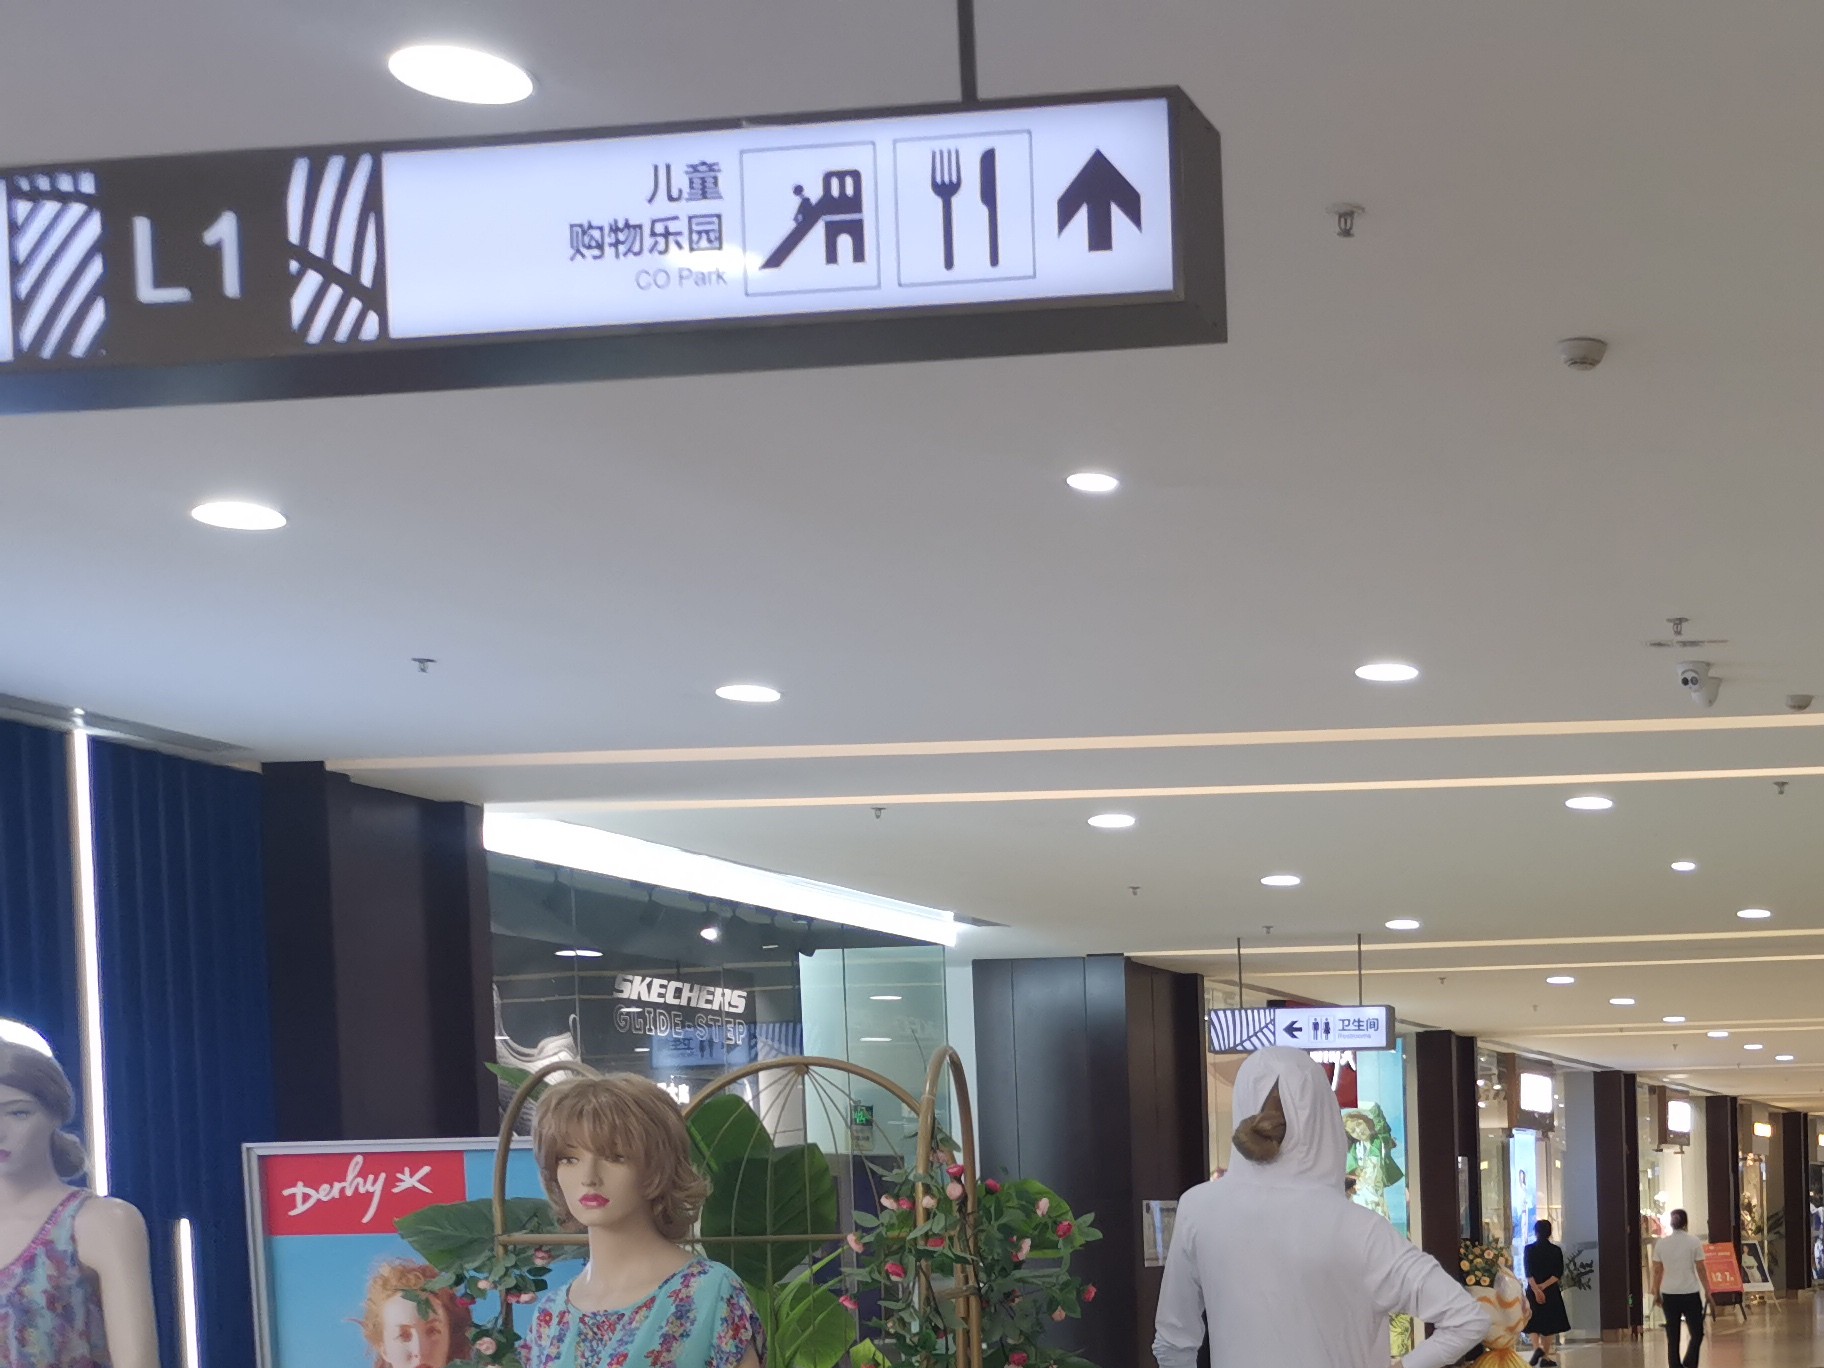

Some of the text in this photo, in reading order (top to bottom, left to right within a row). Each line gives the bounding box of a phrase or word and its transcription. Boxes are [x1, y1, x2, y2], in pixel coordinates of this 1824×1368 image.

[647, 161, 723, 203] 儿童
[132, 210, 241, 304] L1
[569, 213, 722, 261] 购物乐园
[678, 266, 727, 288] Park
[612, 974, 747, 1013] SKECHERS
[614, 1004, 747, 1045] GLIDE-STEP
[1338, 1018, 1380, 1032] 卫生间
[282, 1154, 386, 1223] Derhy
